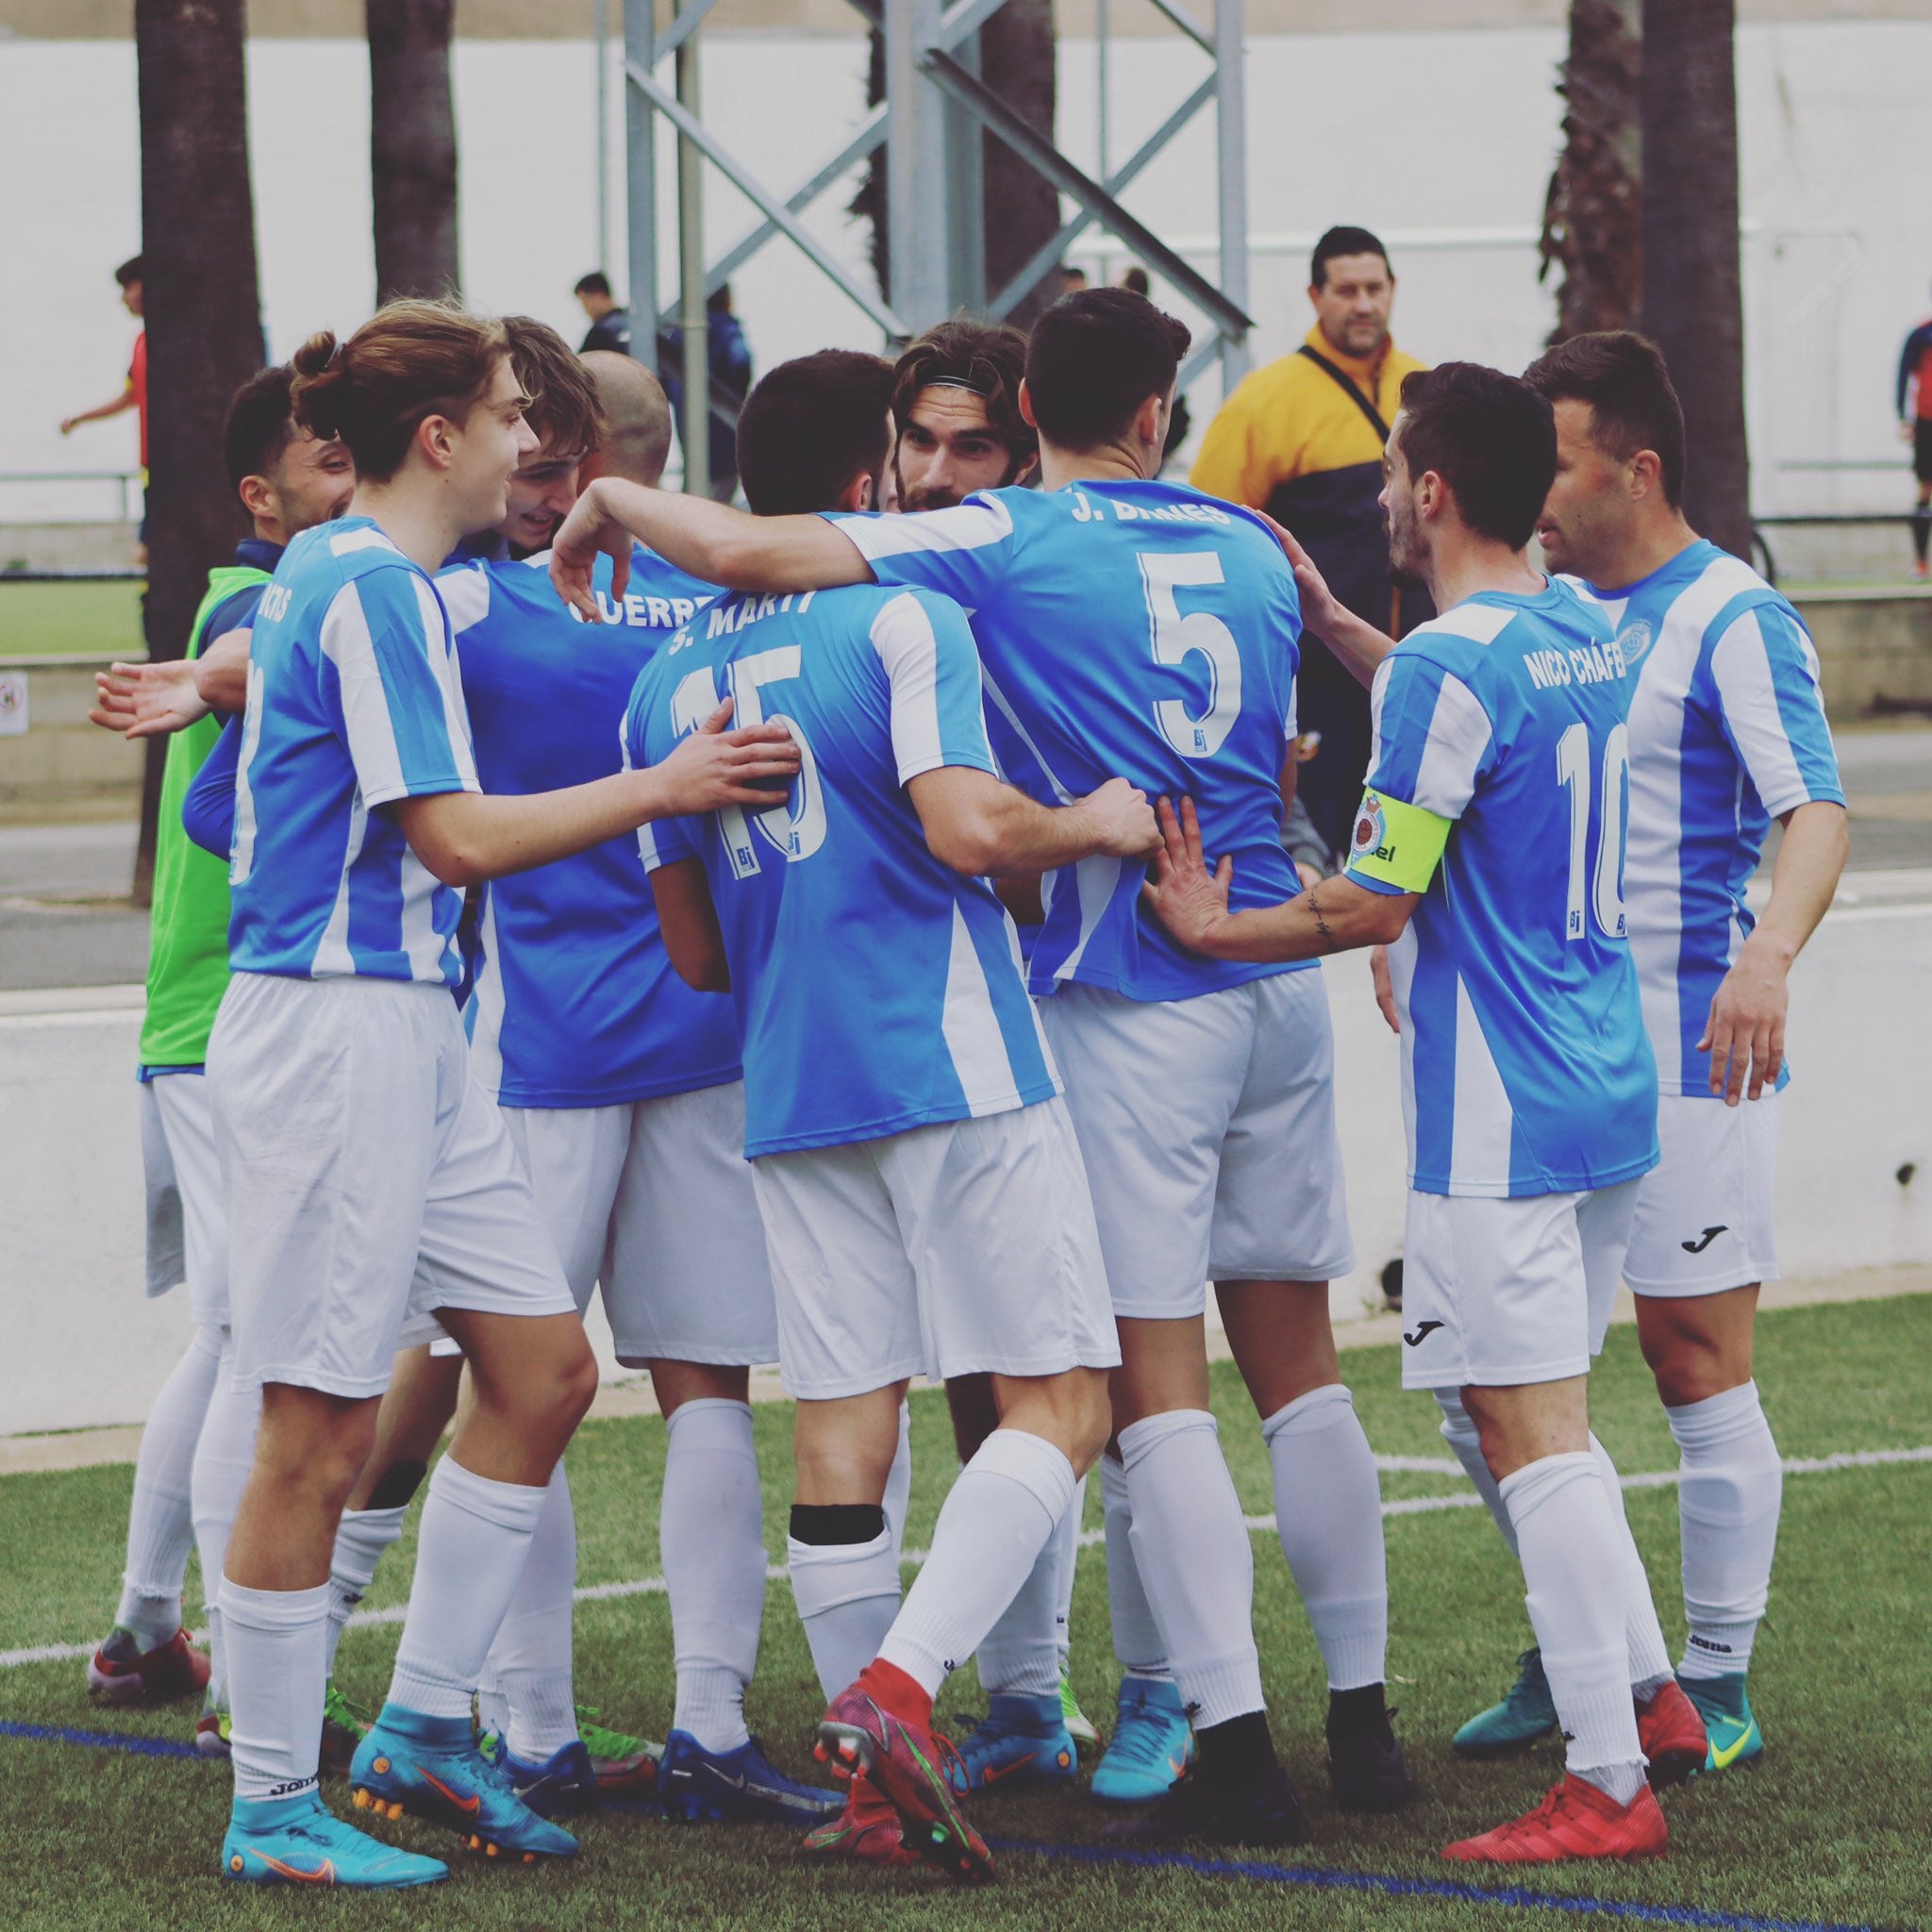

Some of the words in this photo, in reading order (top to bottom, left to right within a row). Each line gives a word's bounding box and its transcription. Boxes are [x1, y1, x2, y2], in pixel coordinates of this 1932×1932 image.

[668, 625, 694, 657] S.
[1135, 551, 1242, 759] 5
[1523, 649, 1572, 691] NICO
[1568, 636, 1627, 686] CHÁFE
[1556, 722, 1630, 941] 10
[270, 1774, 318, 1795] Jom
